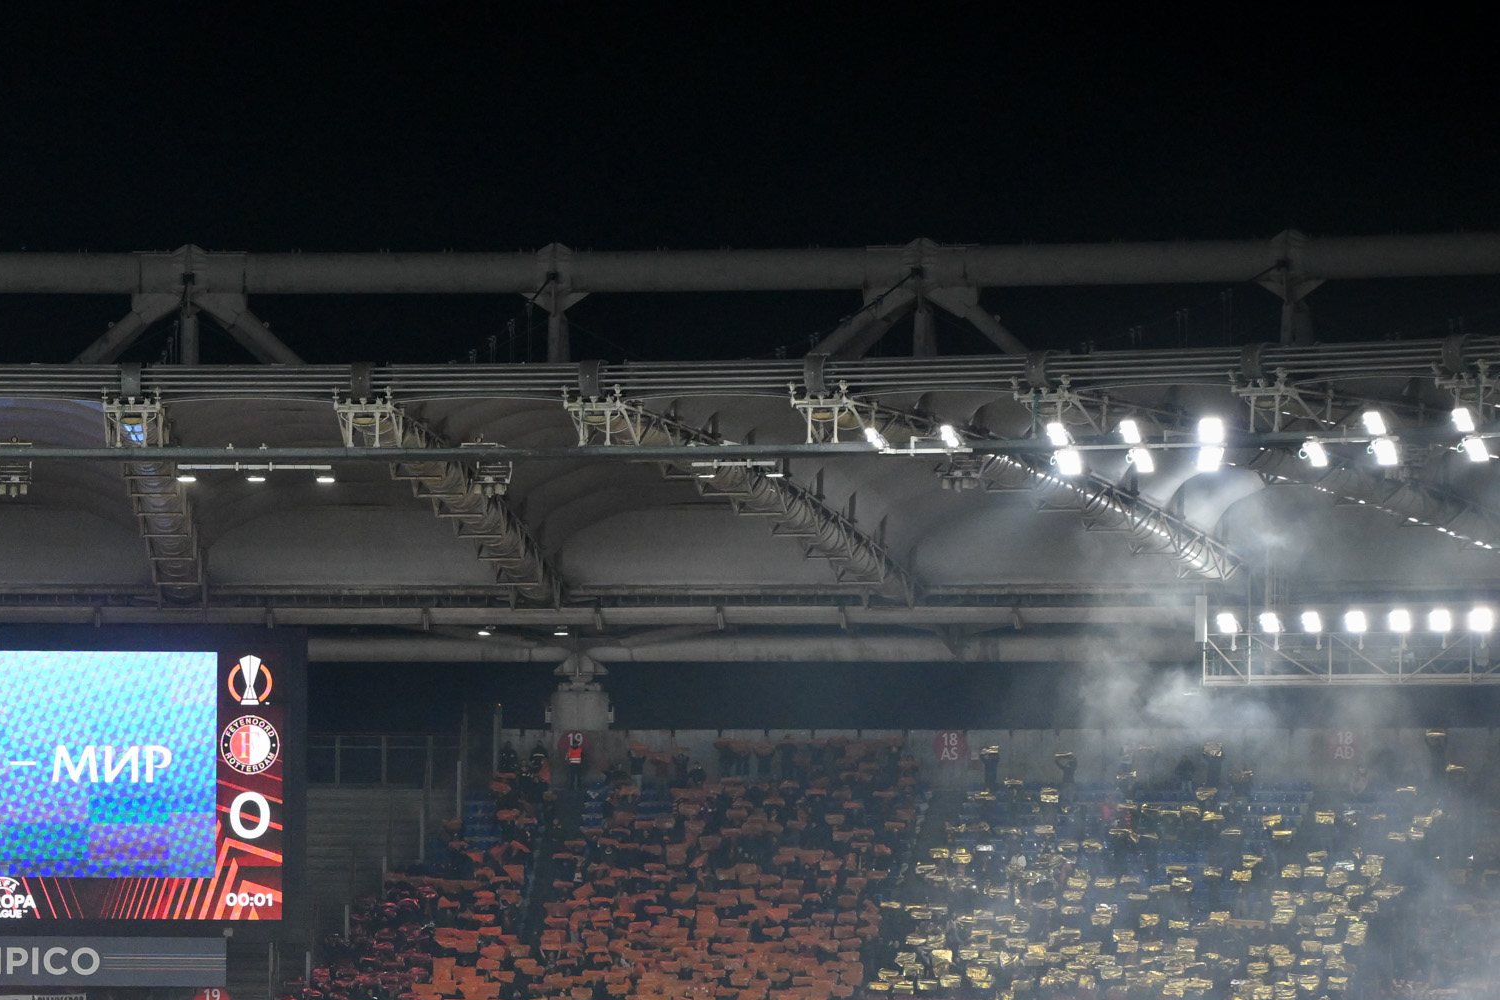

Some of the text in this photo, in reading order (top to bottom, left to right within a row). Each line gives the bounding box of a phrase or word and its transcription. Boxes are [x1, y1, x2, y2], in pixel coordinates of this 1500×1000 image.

[225, 716, 275, 738] FEYENOORD
[568, 732, 583, 747] 19
[942, 732, 958, 746] 18
[1337, 731, 1353, 745] 18
[941, 747, 958, 761] AS
[51, 743, 173, 784] МИР
[224, 752, 276, 773] ROTTERDAM
[229, 791, 271, 840] 0
[225, 892, 273, 907] 00:01
